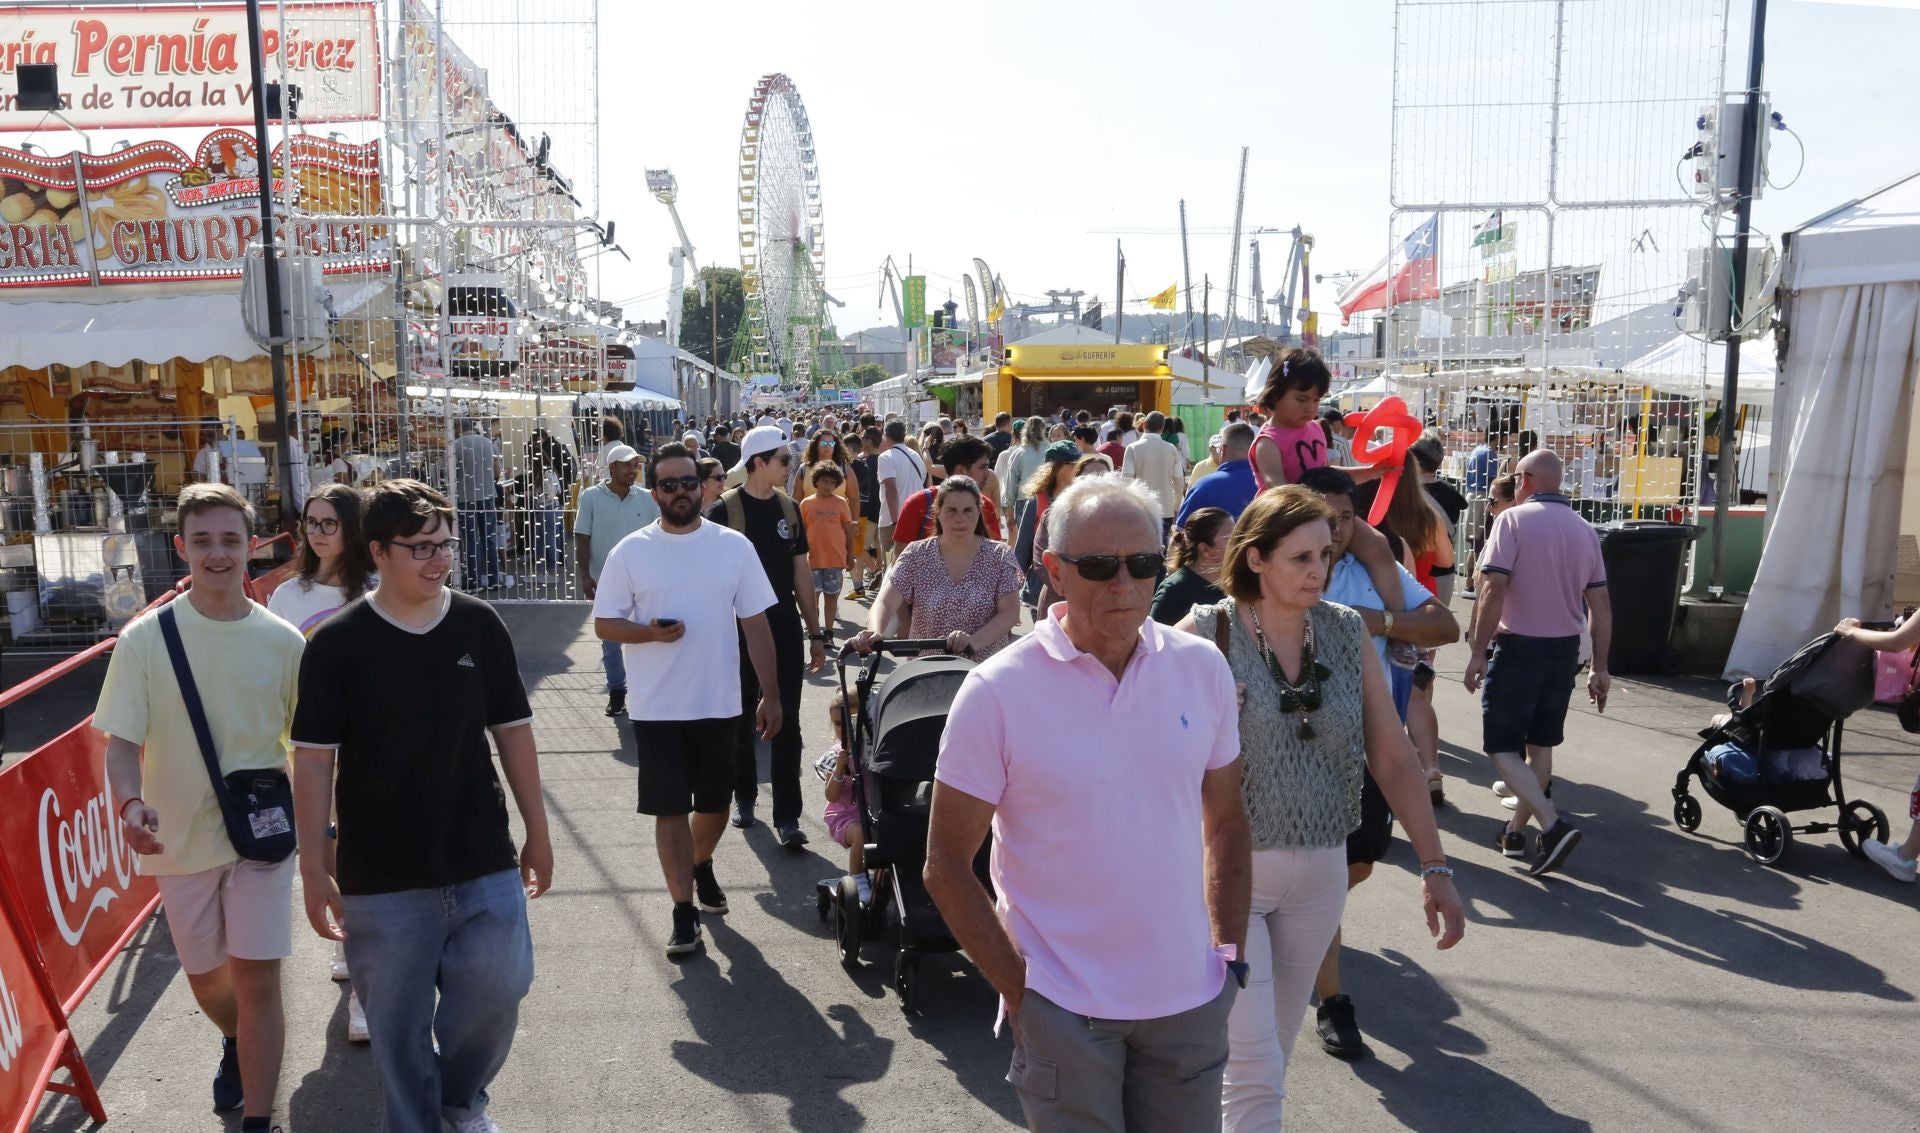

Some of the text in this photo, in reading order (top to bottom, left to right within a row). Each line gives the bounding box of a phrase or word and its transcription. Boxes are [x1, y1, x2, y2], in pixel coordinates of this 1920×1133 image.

[74, 18, 238, 75] Pernía
[81, 84, 114, 110] de
[121, 81, 193, 109] Toda
[201, 81, 226, 107] la
